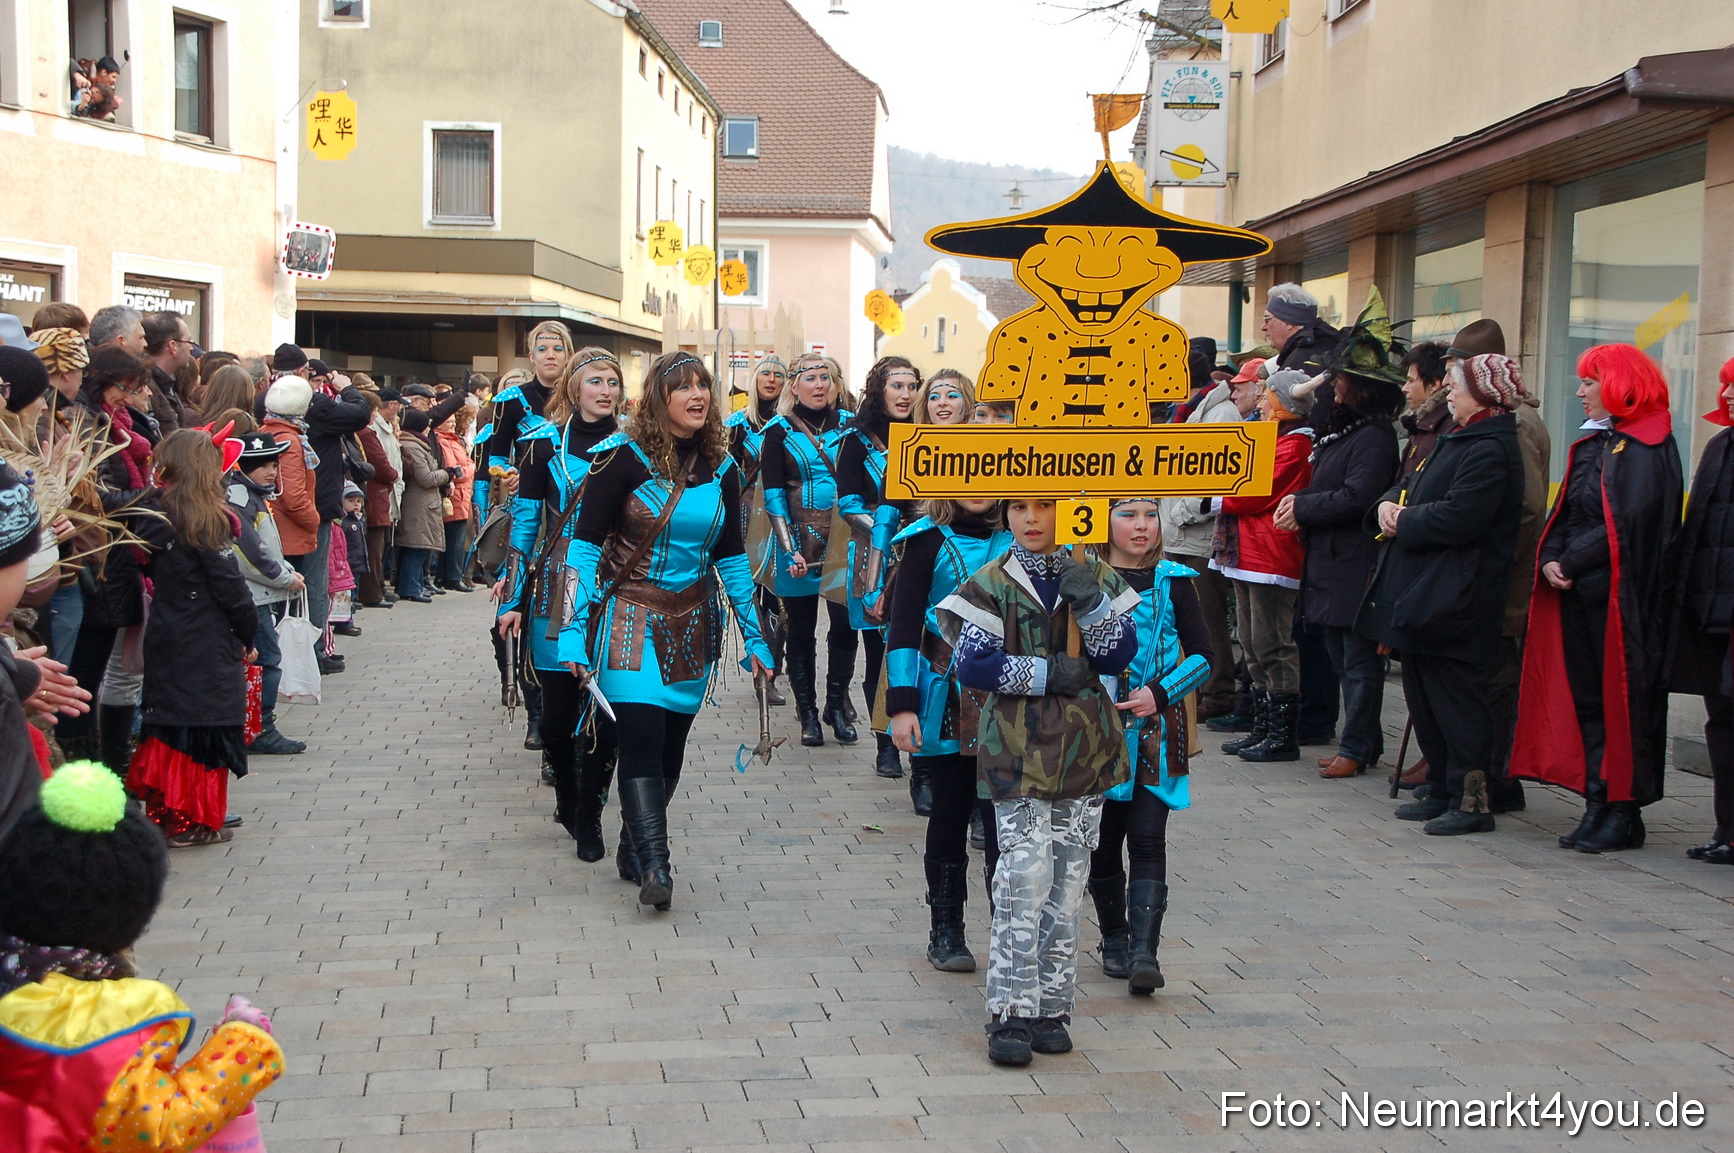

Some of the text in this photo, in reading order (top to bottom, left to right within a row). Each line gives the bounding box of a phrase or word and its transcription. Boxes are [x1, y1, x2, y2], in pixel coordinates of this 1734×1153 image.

[1209, 77, 1223, 98] SUN
[123, 294, 196, 316] DECHANT
[913, 445, 1242, 484] Gimpertshausen & Friends
[1071, 505, 1095, 538] 3
